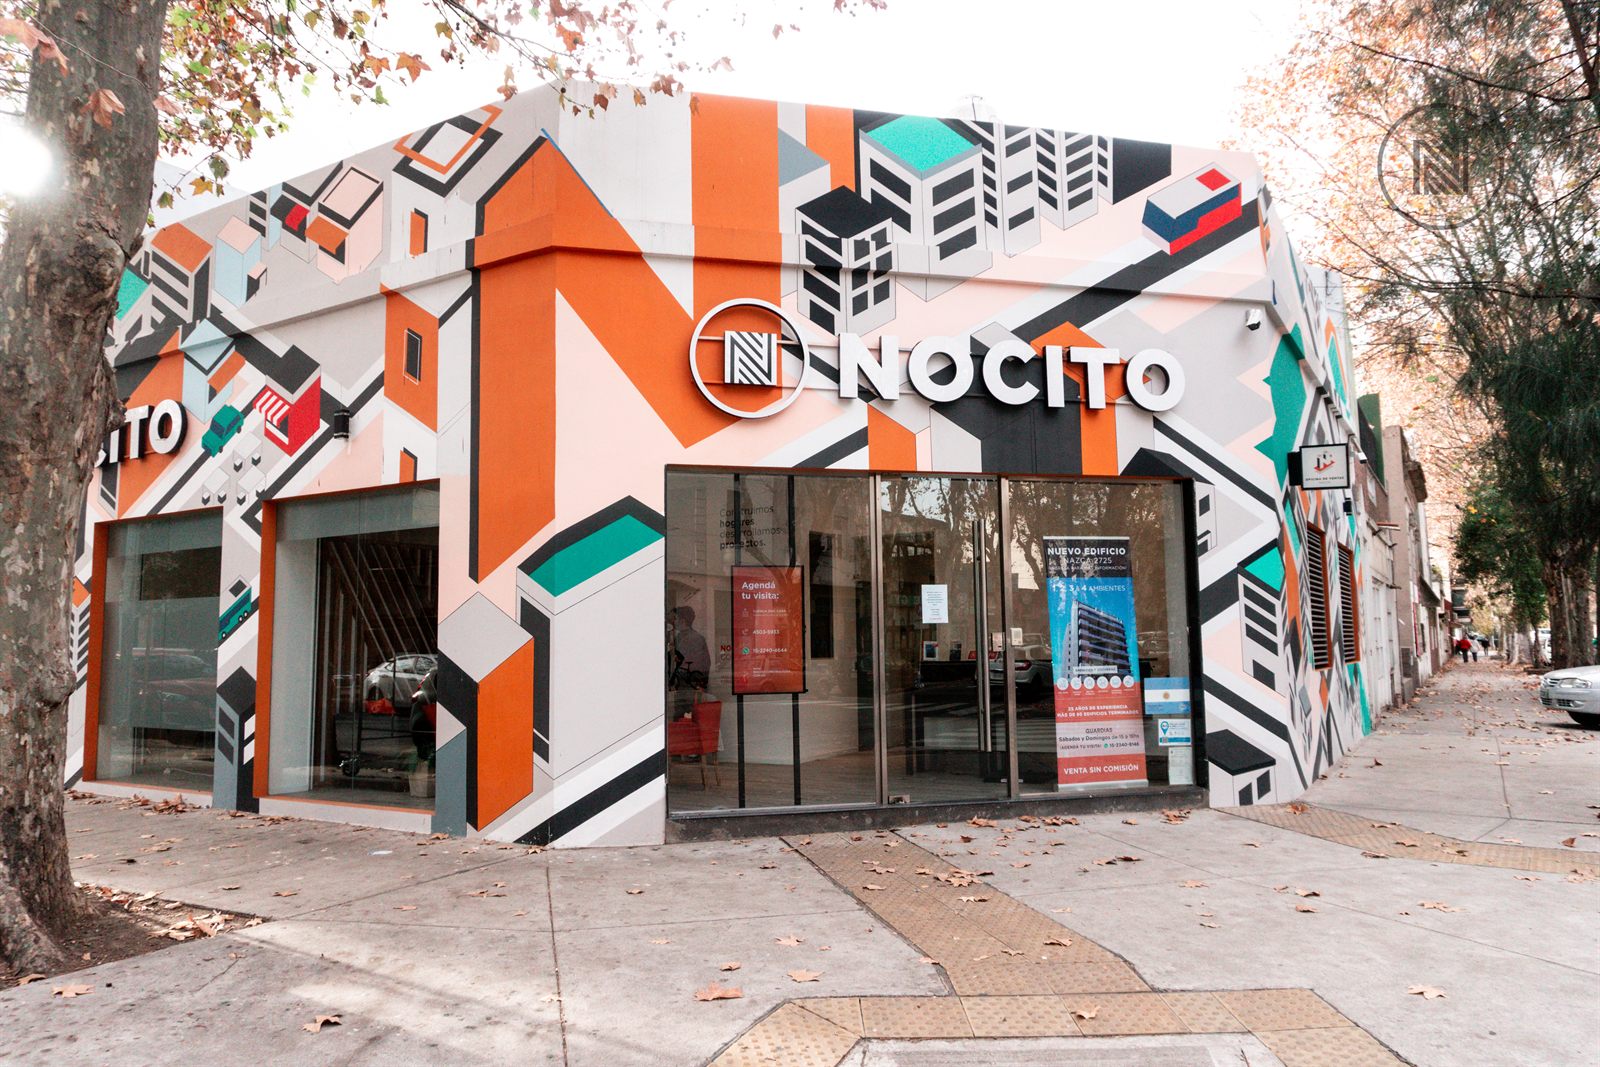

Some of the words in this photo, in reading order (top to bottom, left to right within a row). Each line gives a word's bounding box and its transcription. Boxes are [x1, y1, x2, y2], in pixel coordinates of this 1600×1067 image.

[838, 331, 1186, 412] NOCITO
[95, 398, 187, 468] ITO
[719, 518, 755, 530] hogres
[719, 538, 767, 551] proectos.
[1047, 547, 1081, 556] NUEVO
[1084, 547, 1127, 556] EDIFICIO
[1094, 556, 1113, 564] 2725
[741, 580, 776, 592] Agendá
[741, 592, 751, 601] tu
[753, 591, 780, 601] visita:
[1085, 727, 1113, 735] GUARDIAS
[1085, 734, 1111, 743] Domingos
[1063, 766, 1088, 776] VENTA
[1089, 766, 1102, 774] SIN
[1103, 763, 1139, 774] COMISIÓN
